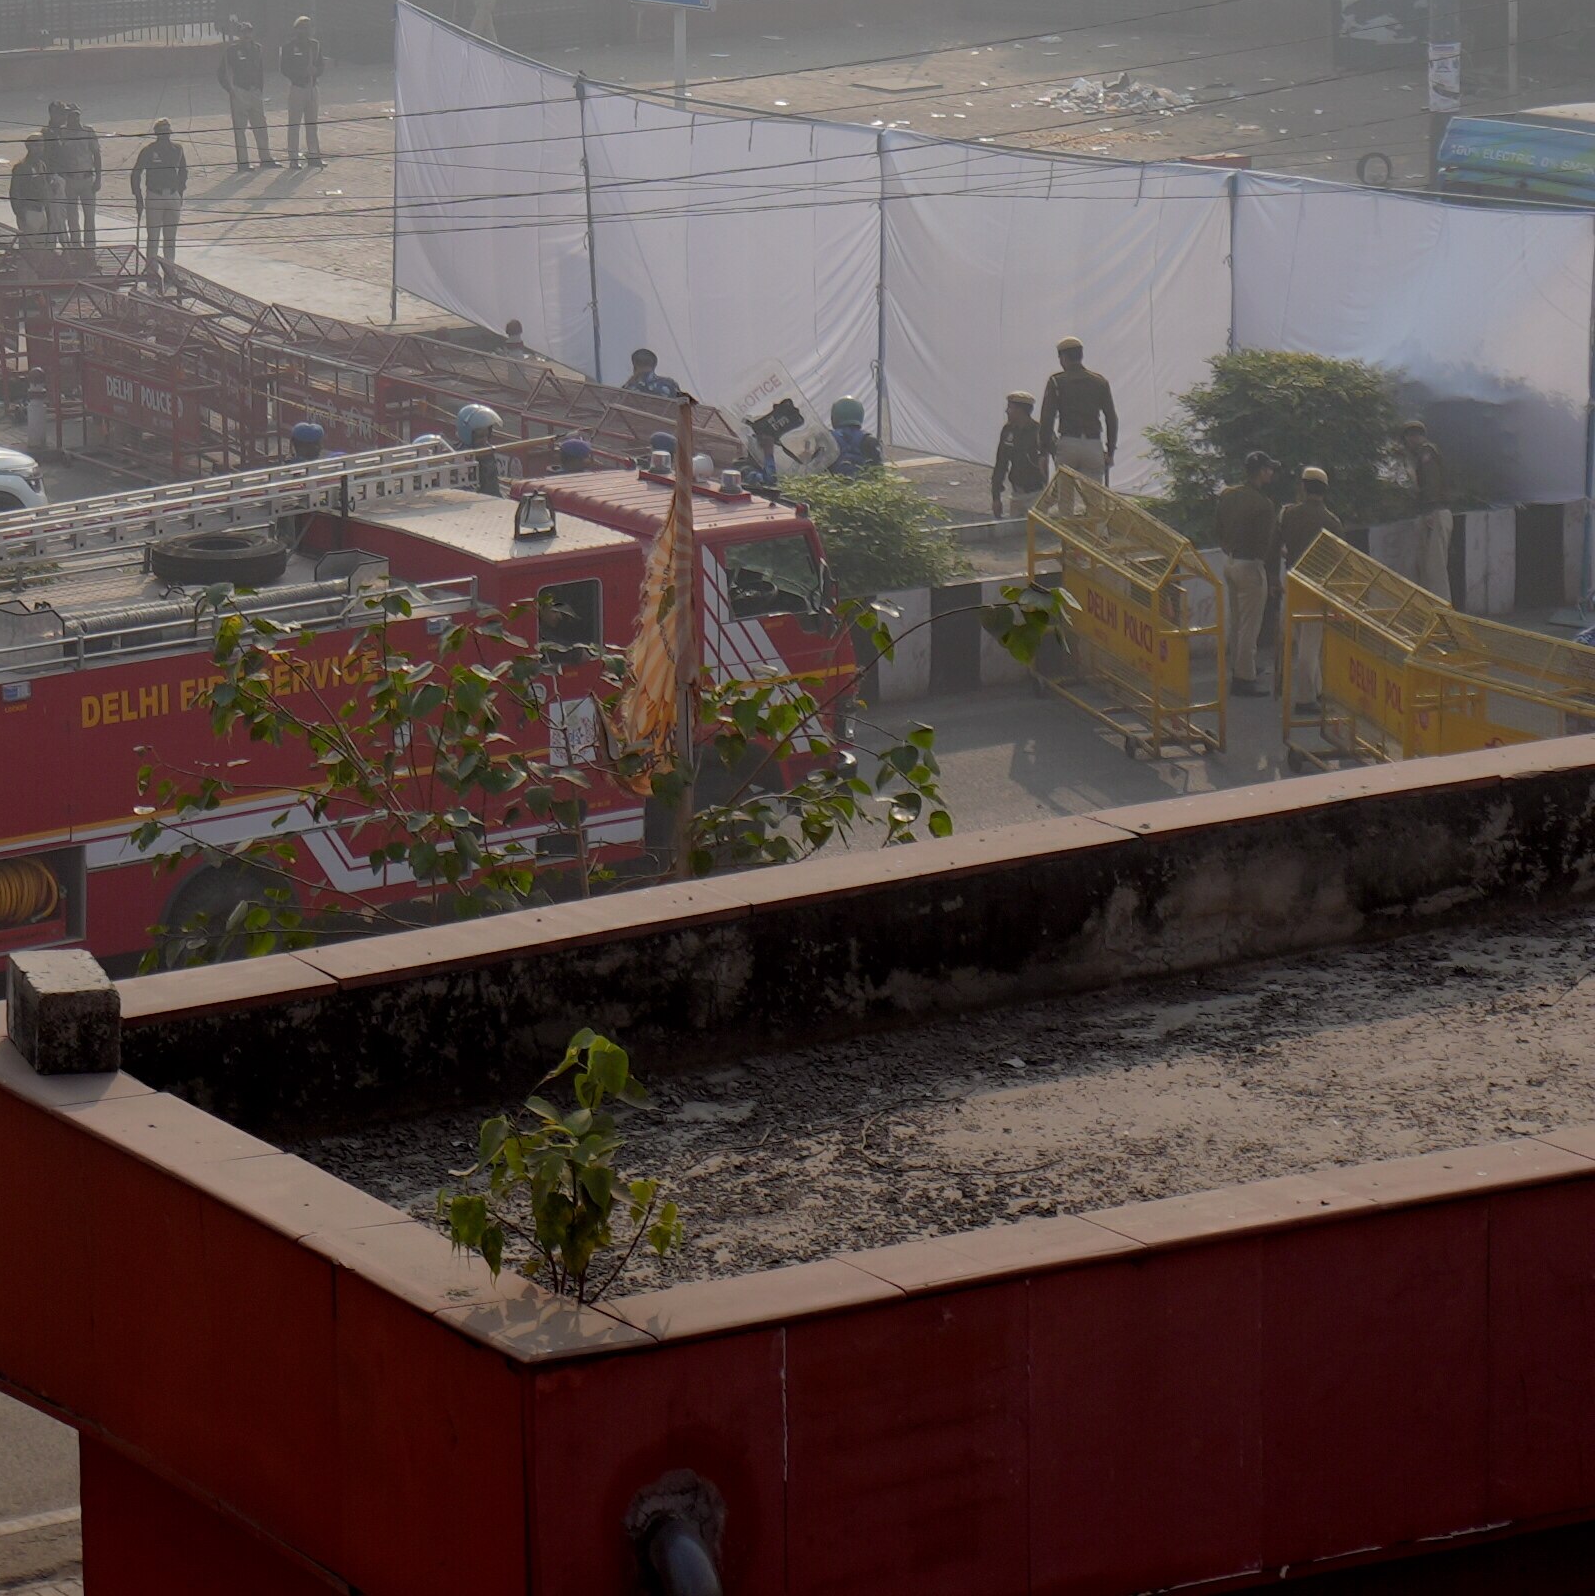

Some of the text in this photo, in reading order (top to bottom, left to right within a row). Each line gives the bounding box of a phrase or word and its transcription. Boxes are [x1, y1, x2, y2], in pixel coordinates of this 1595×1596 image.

[1483, 149, 1537, 166] ELECTRIC
[106, 375, 134, 403] DELHI
[140, 386, 172, 415] POLICE
[1087, 587, 1117, 630] DELHI
[81, 683, 169, 729] DELHI
[264, 649, 380, 698] SERVICE
[1349, 656, 1377, 700] DELHI
